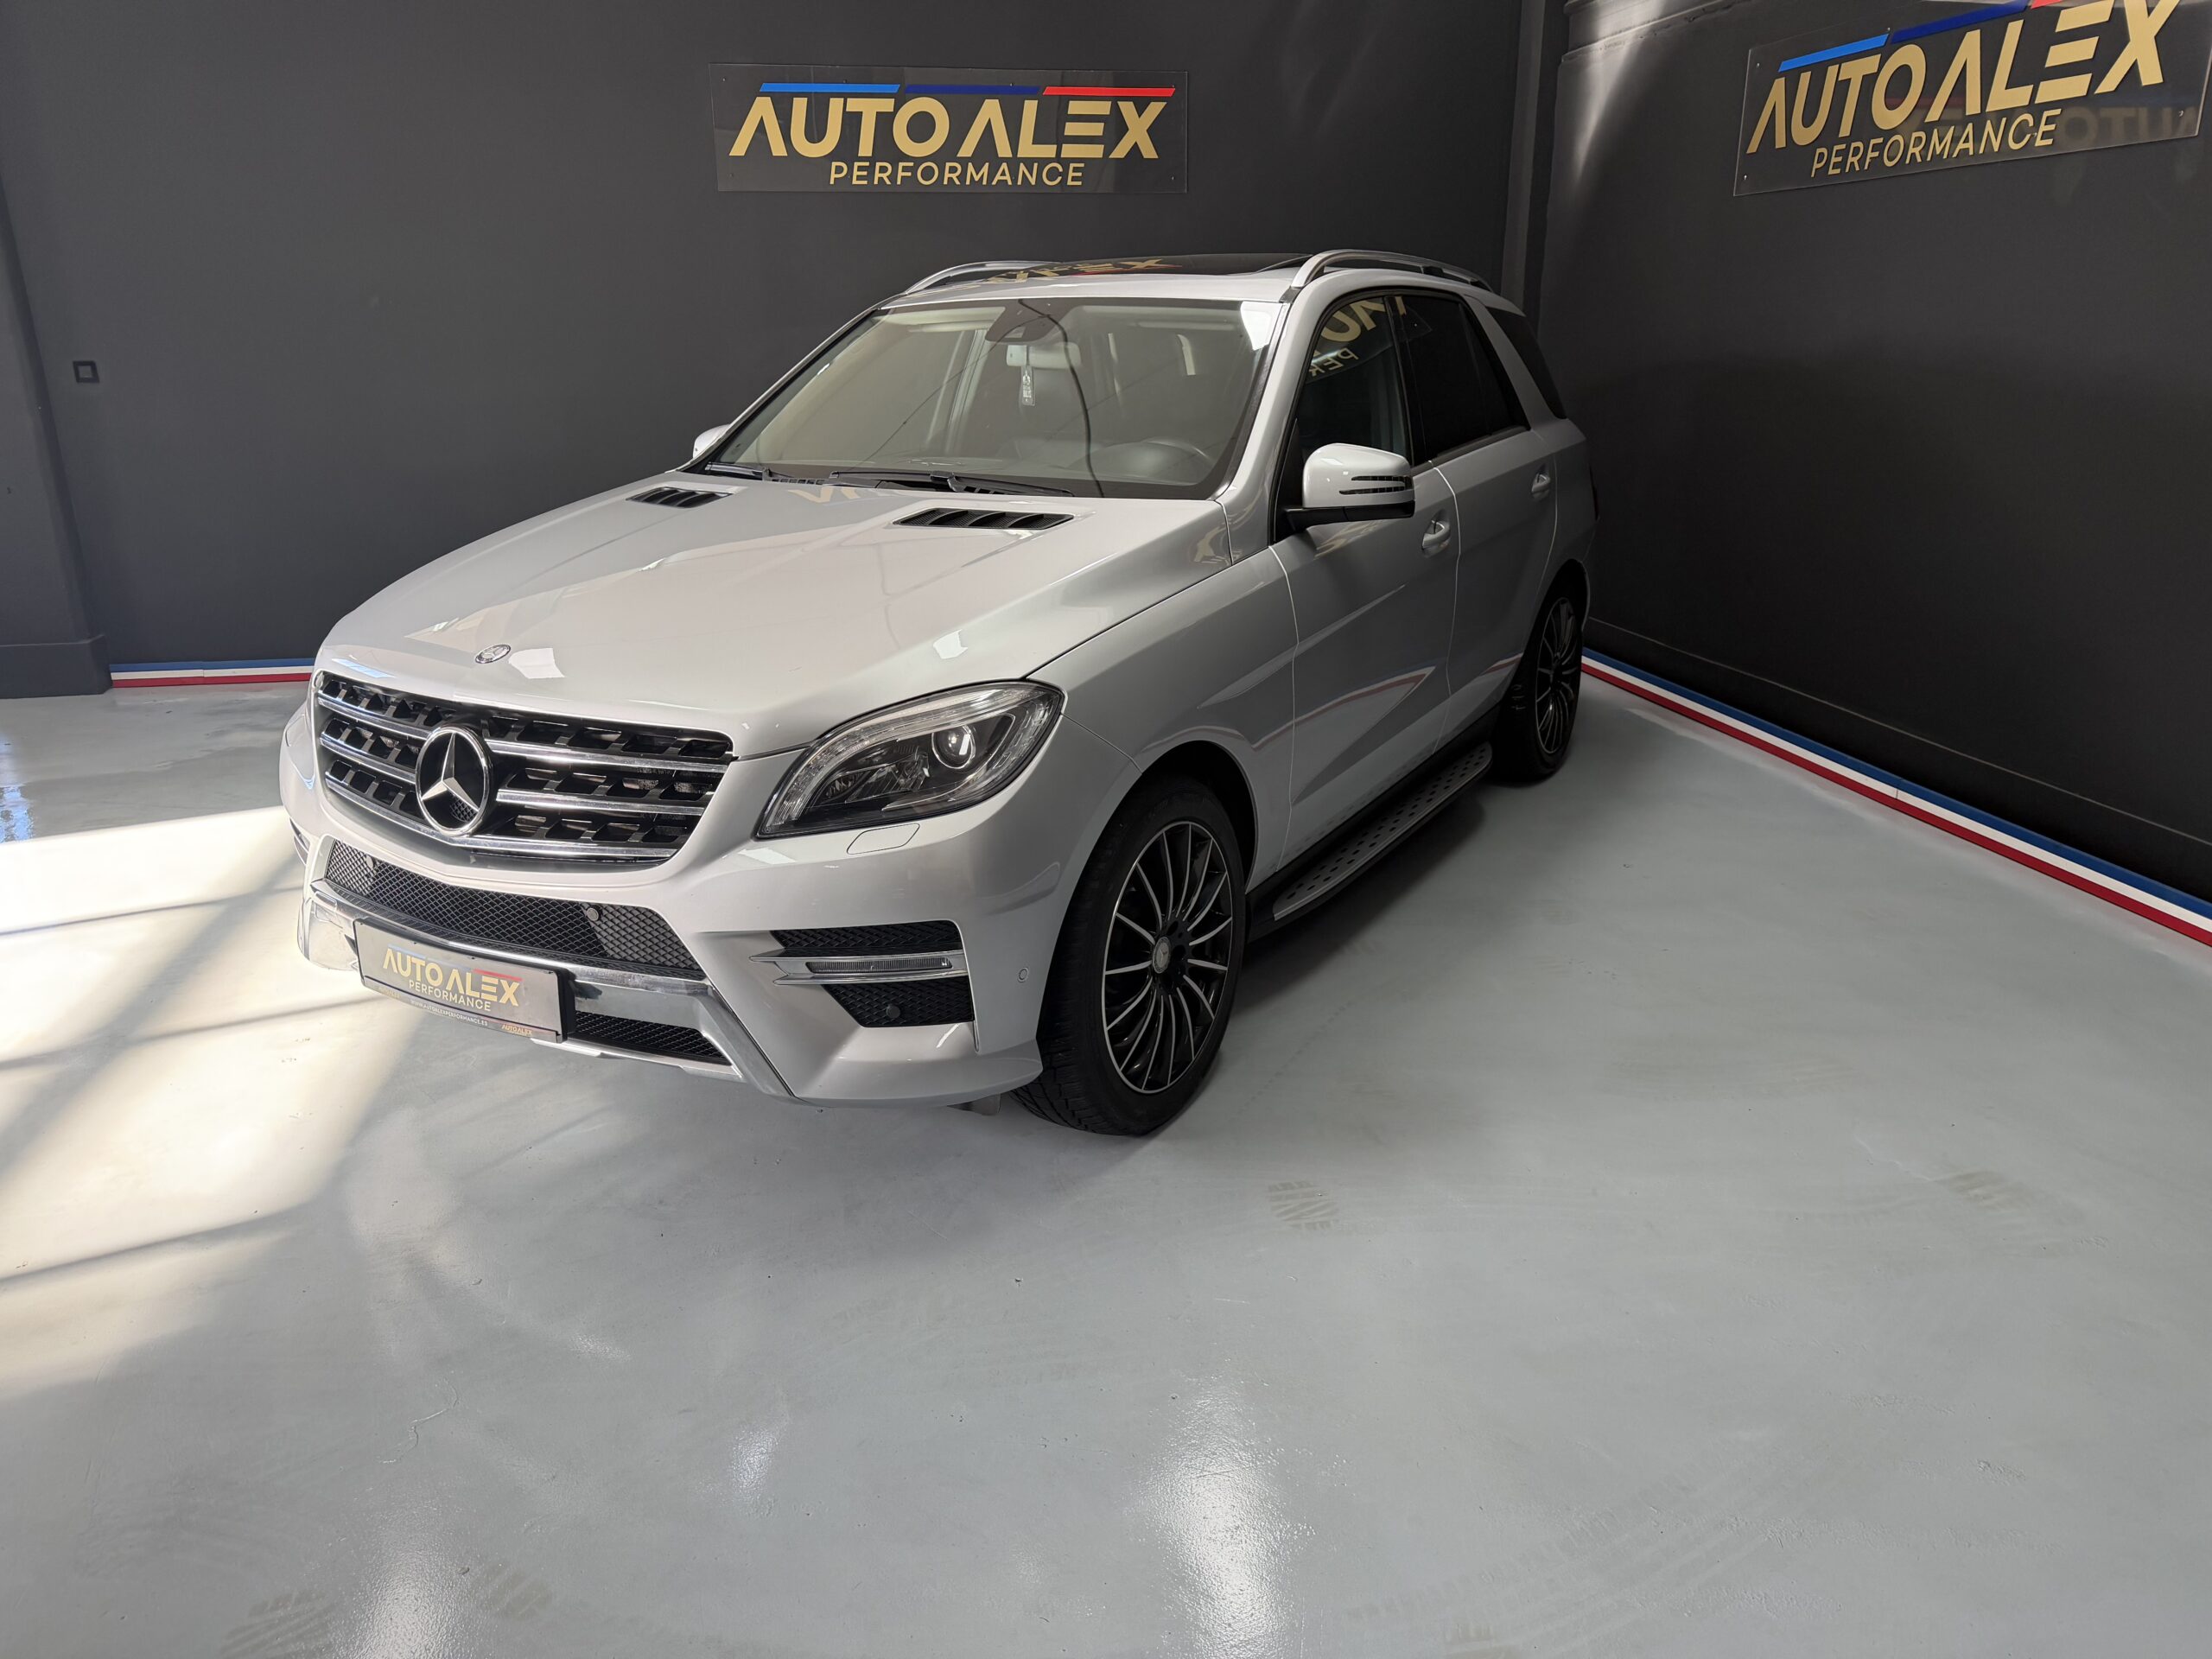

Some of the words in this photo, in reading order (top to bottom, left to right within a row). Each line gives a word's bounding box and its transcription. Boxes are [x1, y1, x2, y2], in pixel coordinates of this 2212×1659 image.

[728, 96, 950, 157] AUTO
[957, 99, 1167, 159] ALEX
[1810, 108, 2062, 178] PERFORMANCE
[829, 161, 1085, 186] PERFORMANCE
[409, 979, 492, 1012] PERFORMANCE
